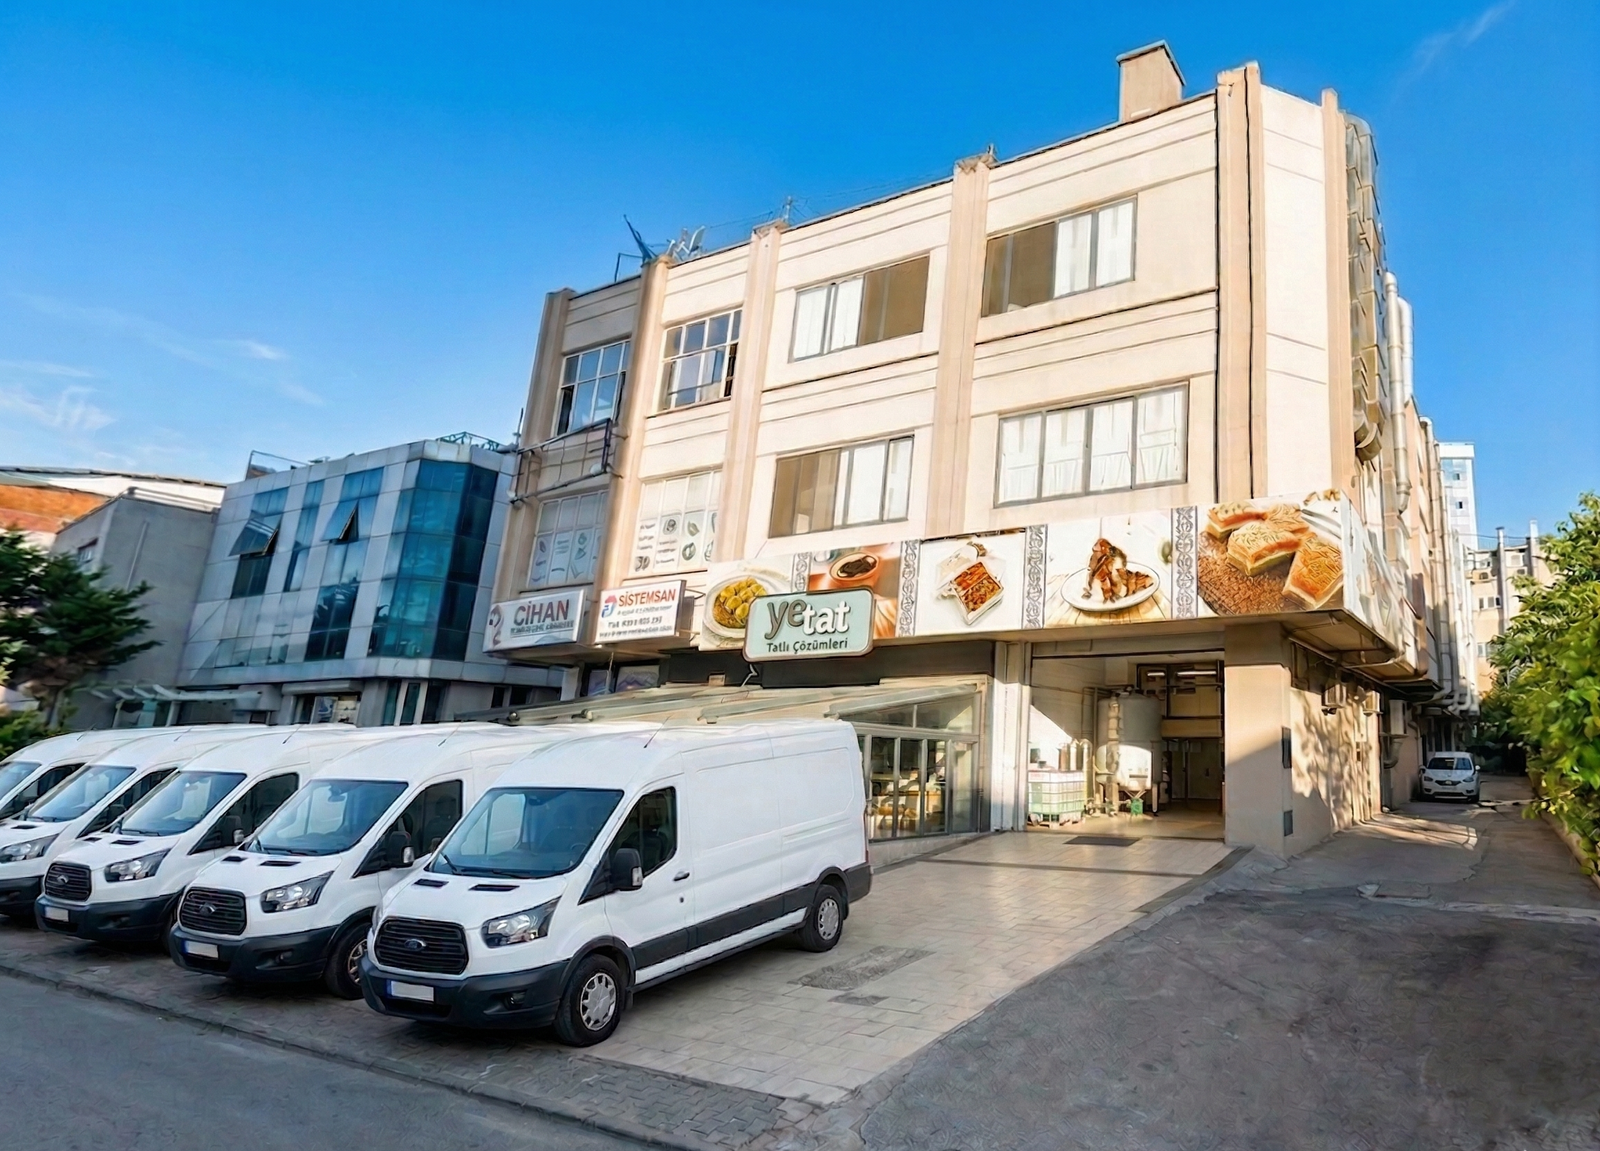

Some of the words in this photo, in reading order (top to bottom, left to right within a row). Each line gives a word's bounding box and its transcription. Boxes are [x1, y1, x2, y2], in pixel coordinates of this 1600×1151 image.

[618, 589, 676, 607] SİSTEMSAN
[513, 599, 569, 626] CİHAN
[764, 599, 850, 640] yetat
[766, 641, 790, 653] Tatlı
[792, 637, 848, 654] Çözümleri
